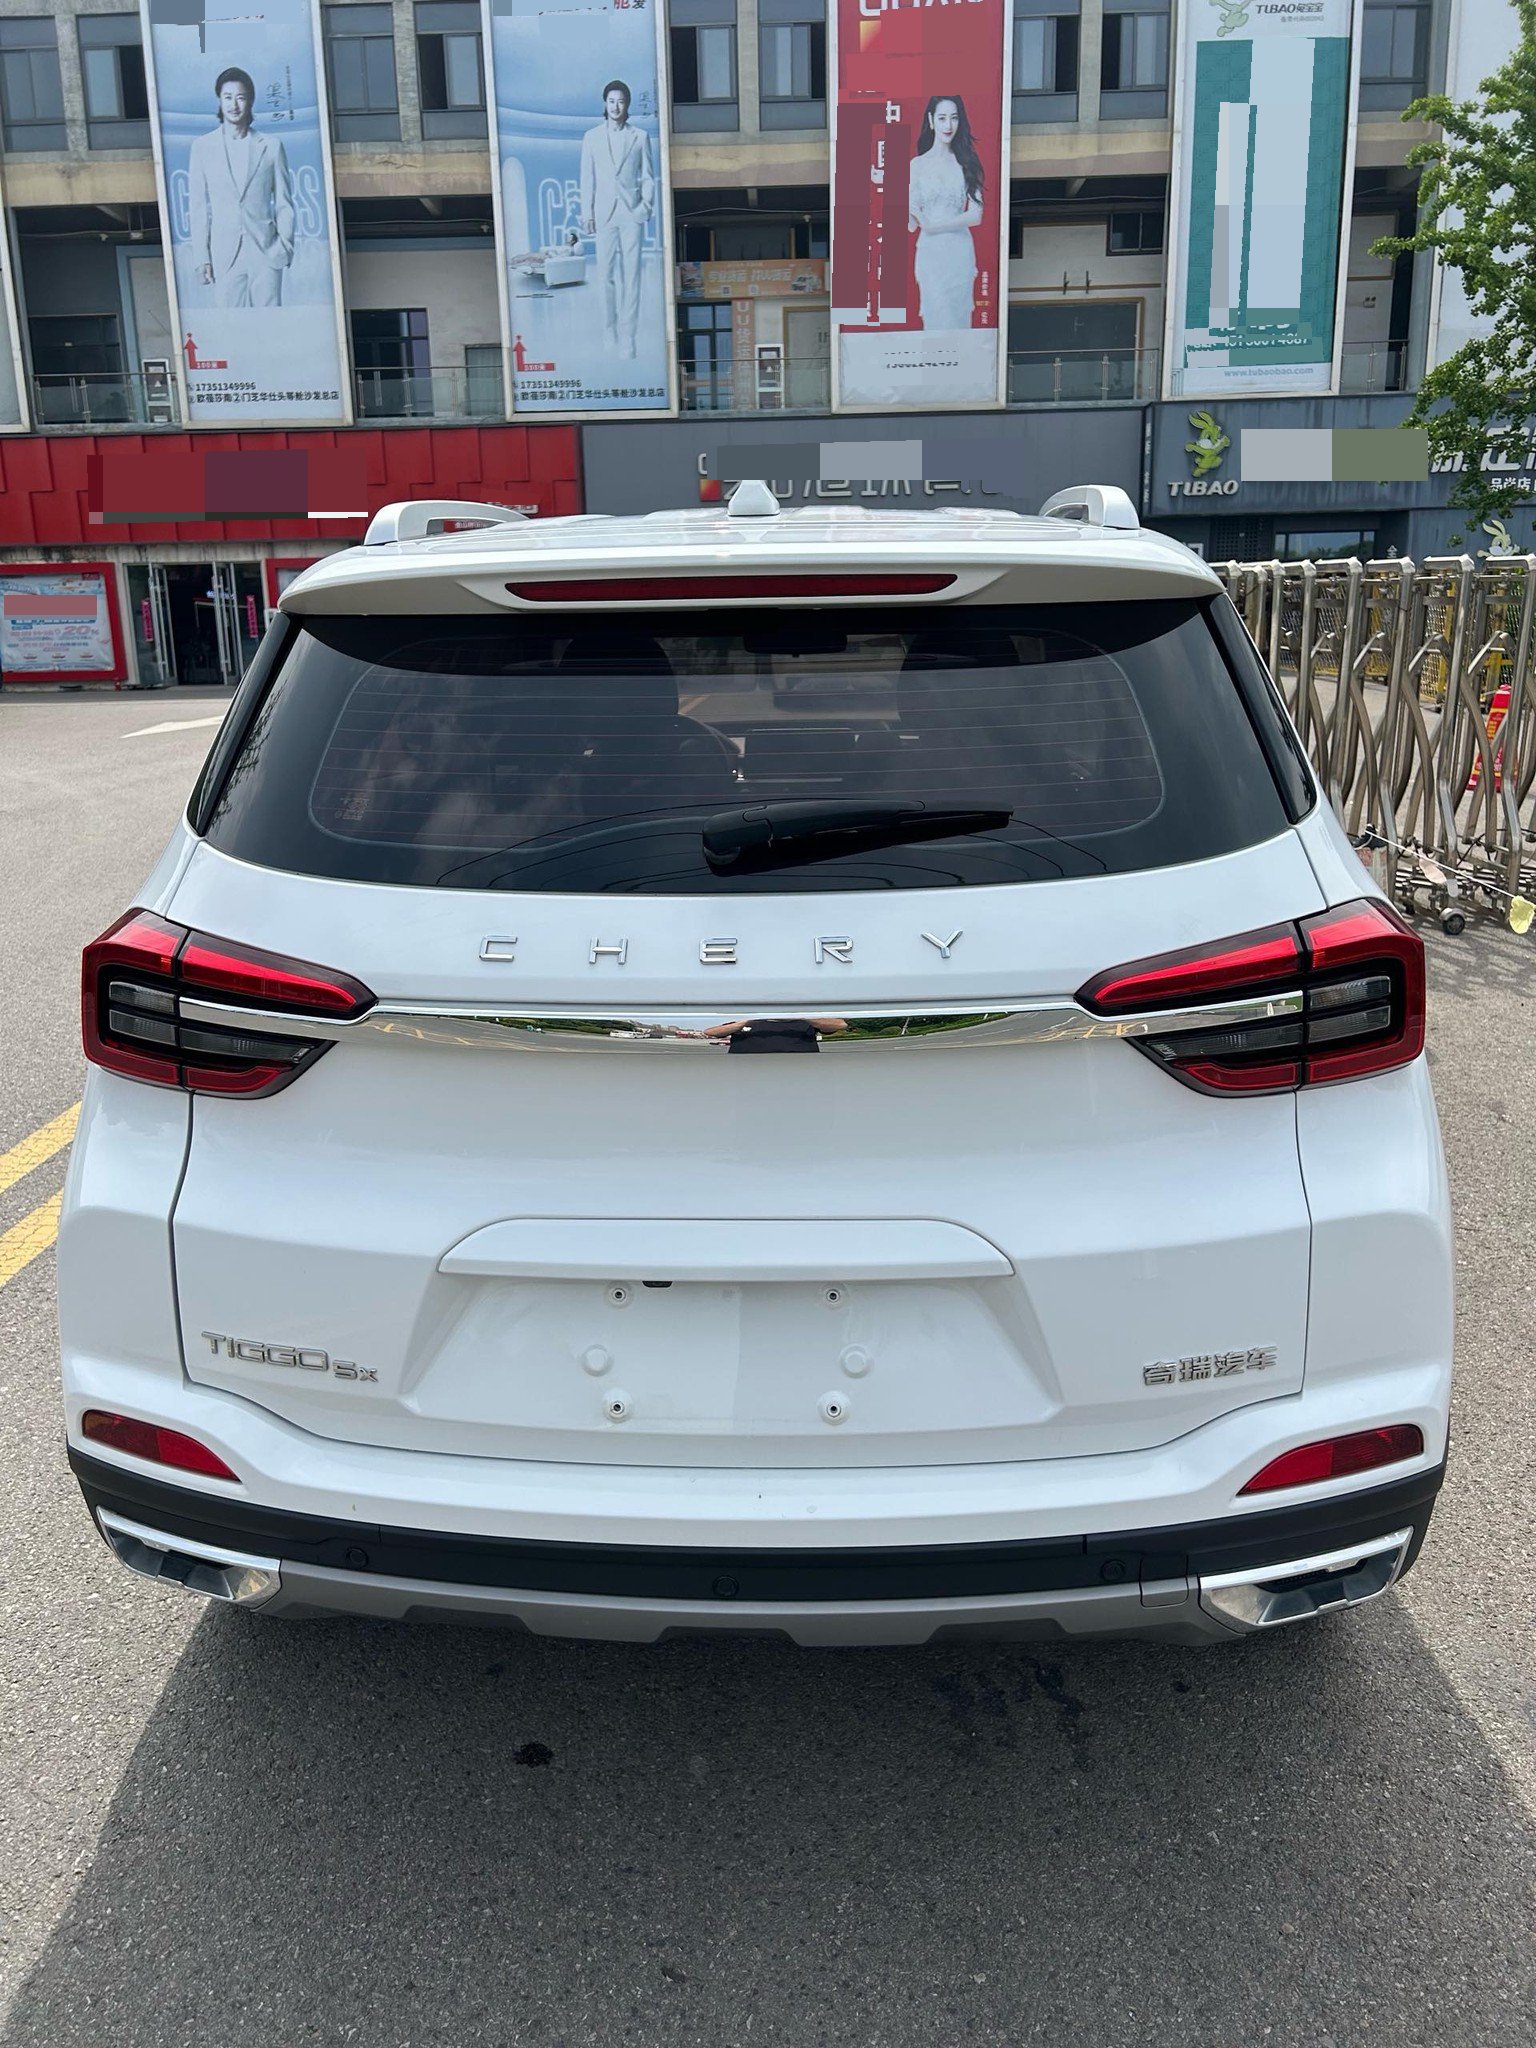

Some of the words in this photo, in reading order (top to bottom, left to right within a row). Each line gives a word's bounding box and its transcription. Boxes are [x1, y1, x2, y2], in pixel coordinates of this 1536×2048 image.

[196, 382, 257, 391] 17351349996
[478, 929, 964, 965] CHERY
[201, 1331, 329, 1371] TIGGO
[1143, 1345, 1278, 1386] 奇瑞汽车
